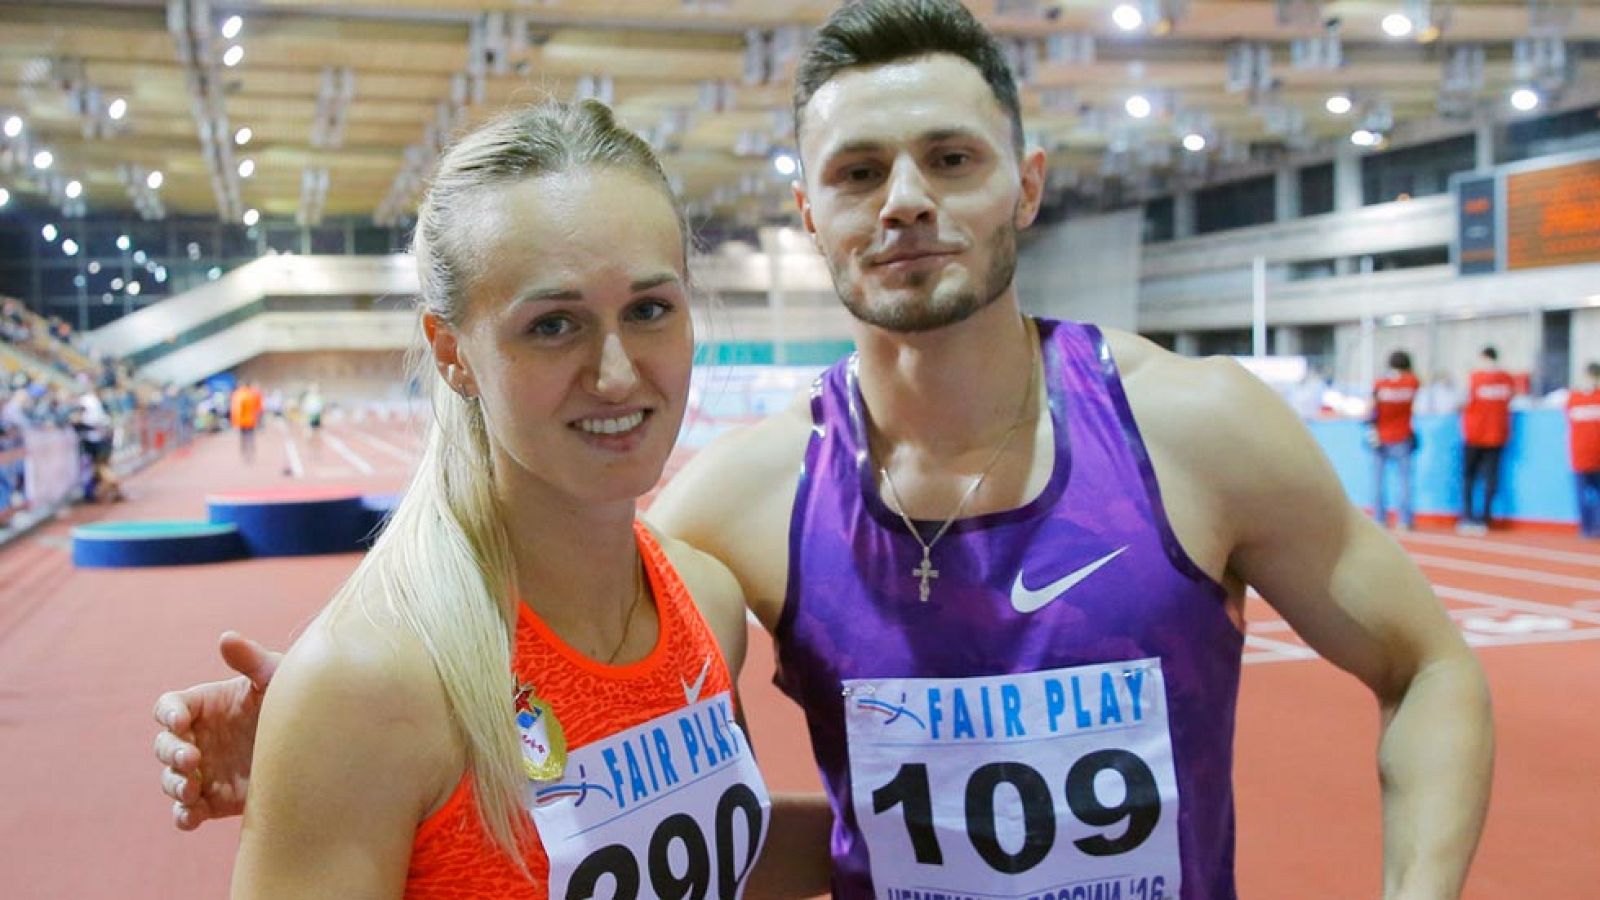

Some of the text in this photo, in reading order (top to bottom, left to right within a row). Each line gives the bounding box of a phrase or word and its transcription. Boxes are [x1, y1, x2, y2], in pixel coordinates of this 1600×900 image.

[602, 702, 739, 809] FAIR PLAY
[927, 668, 1143, 739] FAIR PLAY
[871, 748, 1161, 875] 109
